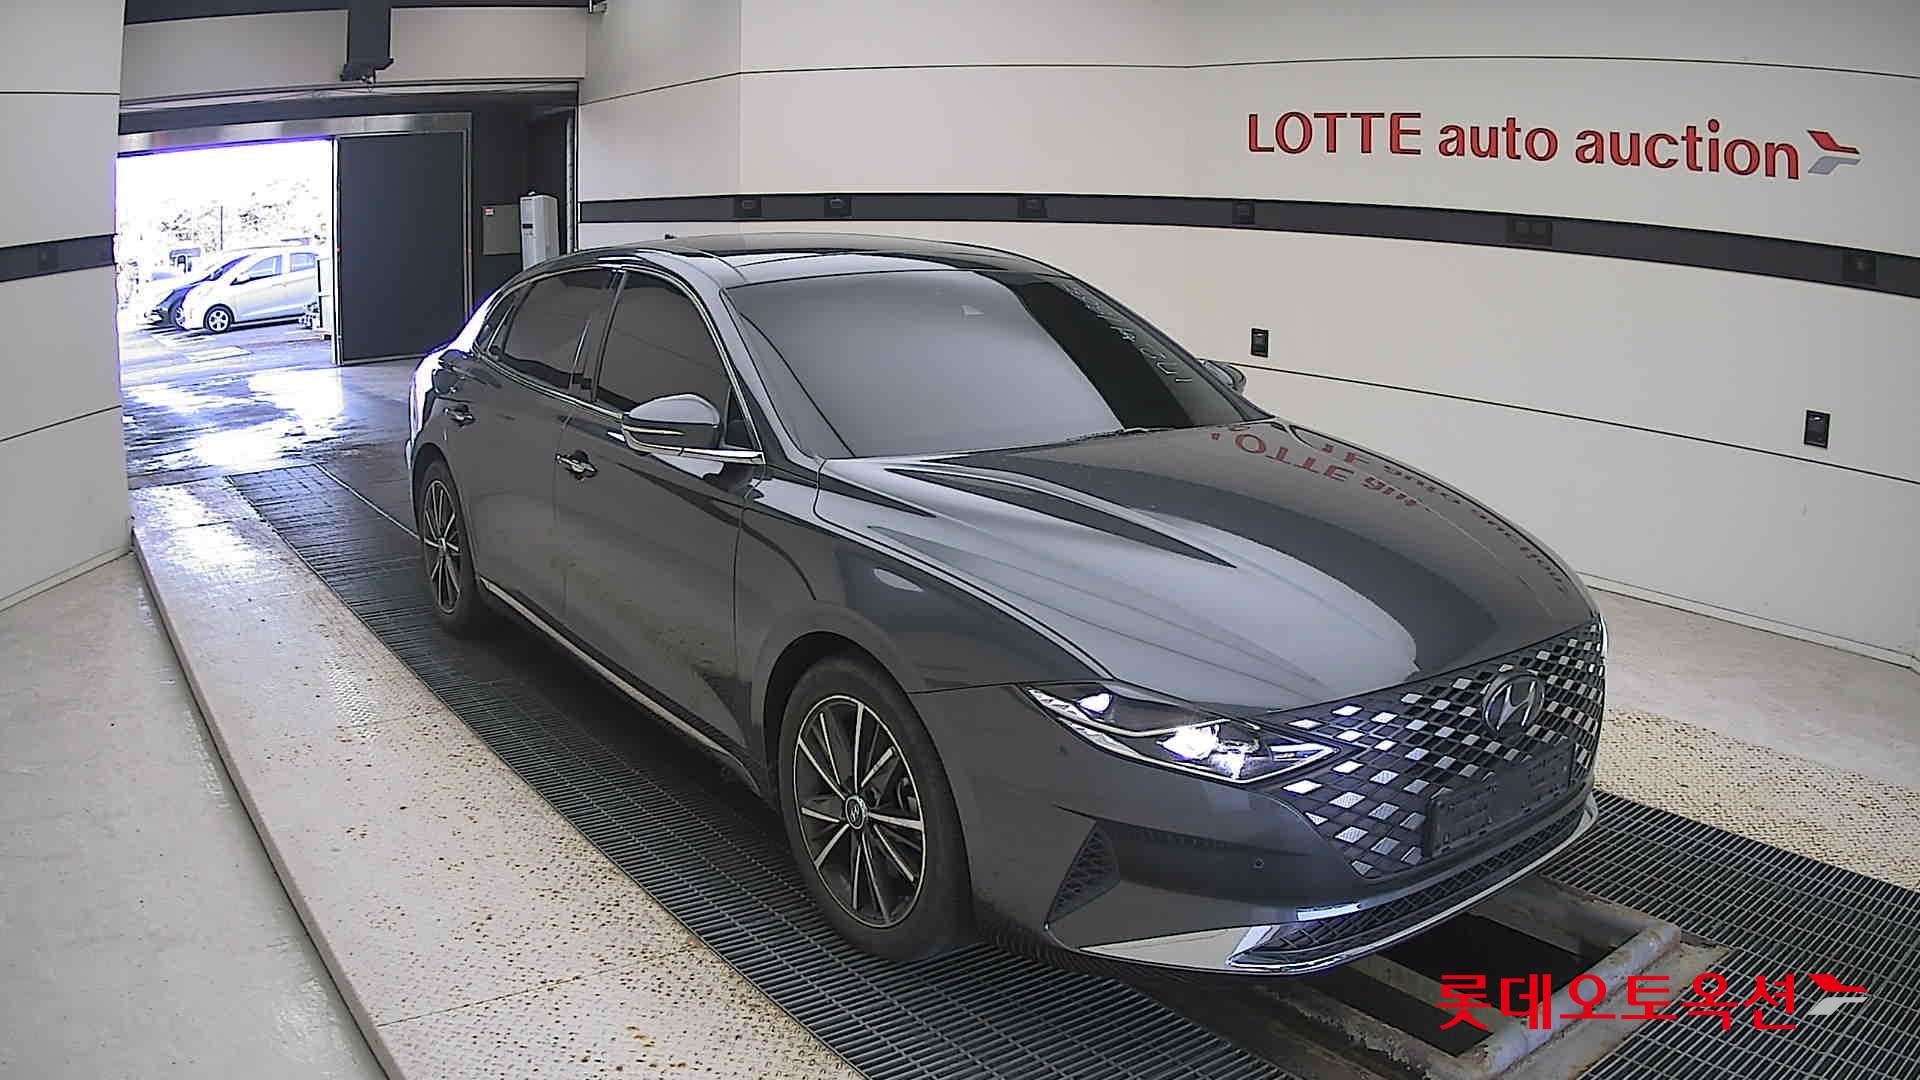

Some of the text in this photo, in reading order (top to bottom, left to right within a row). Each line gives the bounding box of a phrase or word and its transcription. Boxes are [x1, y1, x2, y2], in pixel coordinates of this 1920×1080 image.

[1247, 111, 1800, 180] LOTTE auto auction
